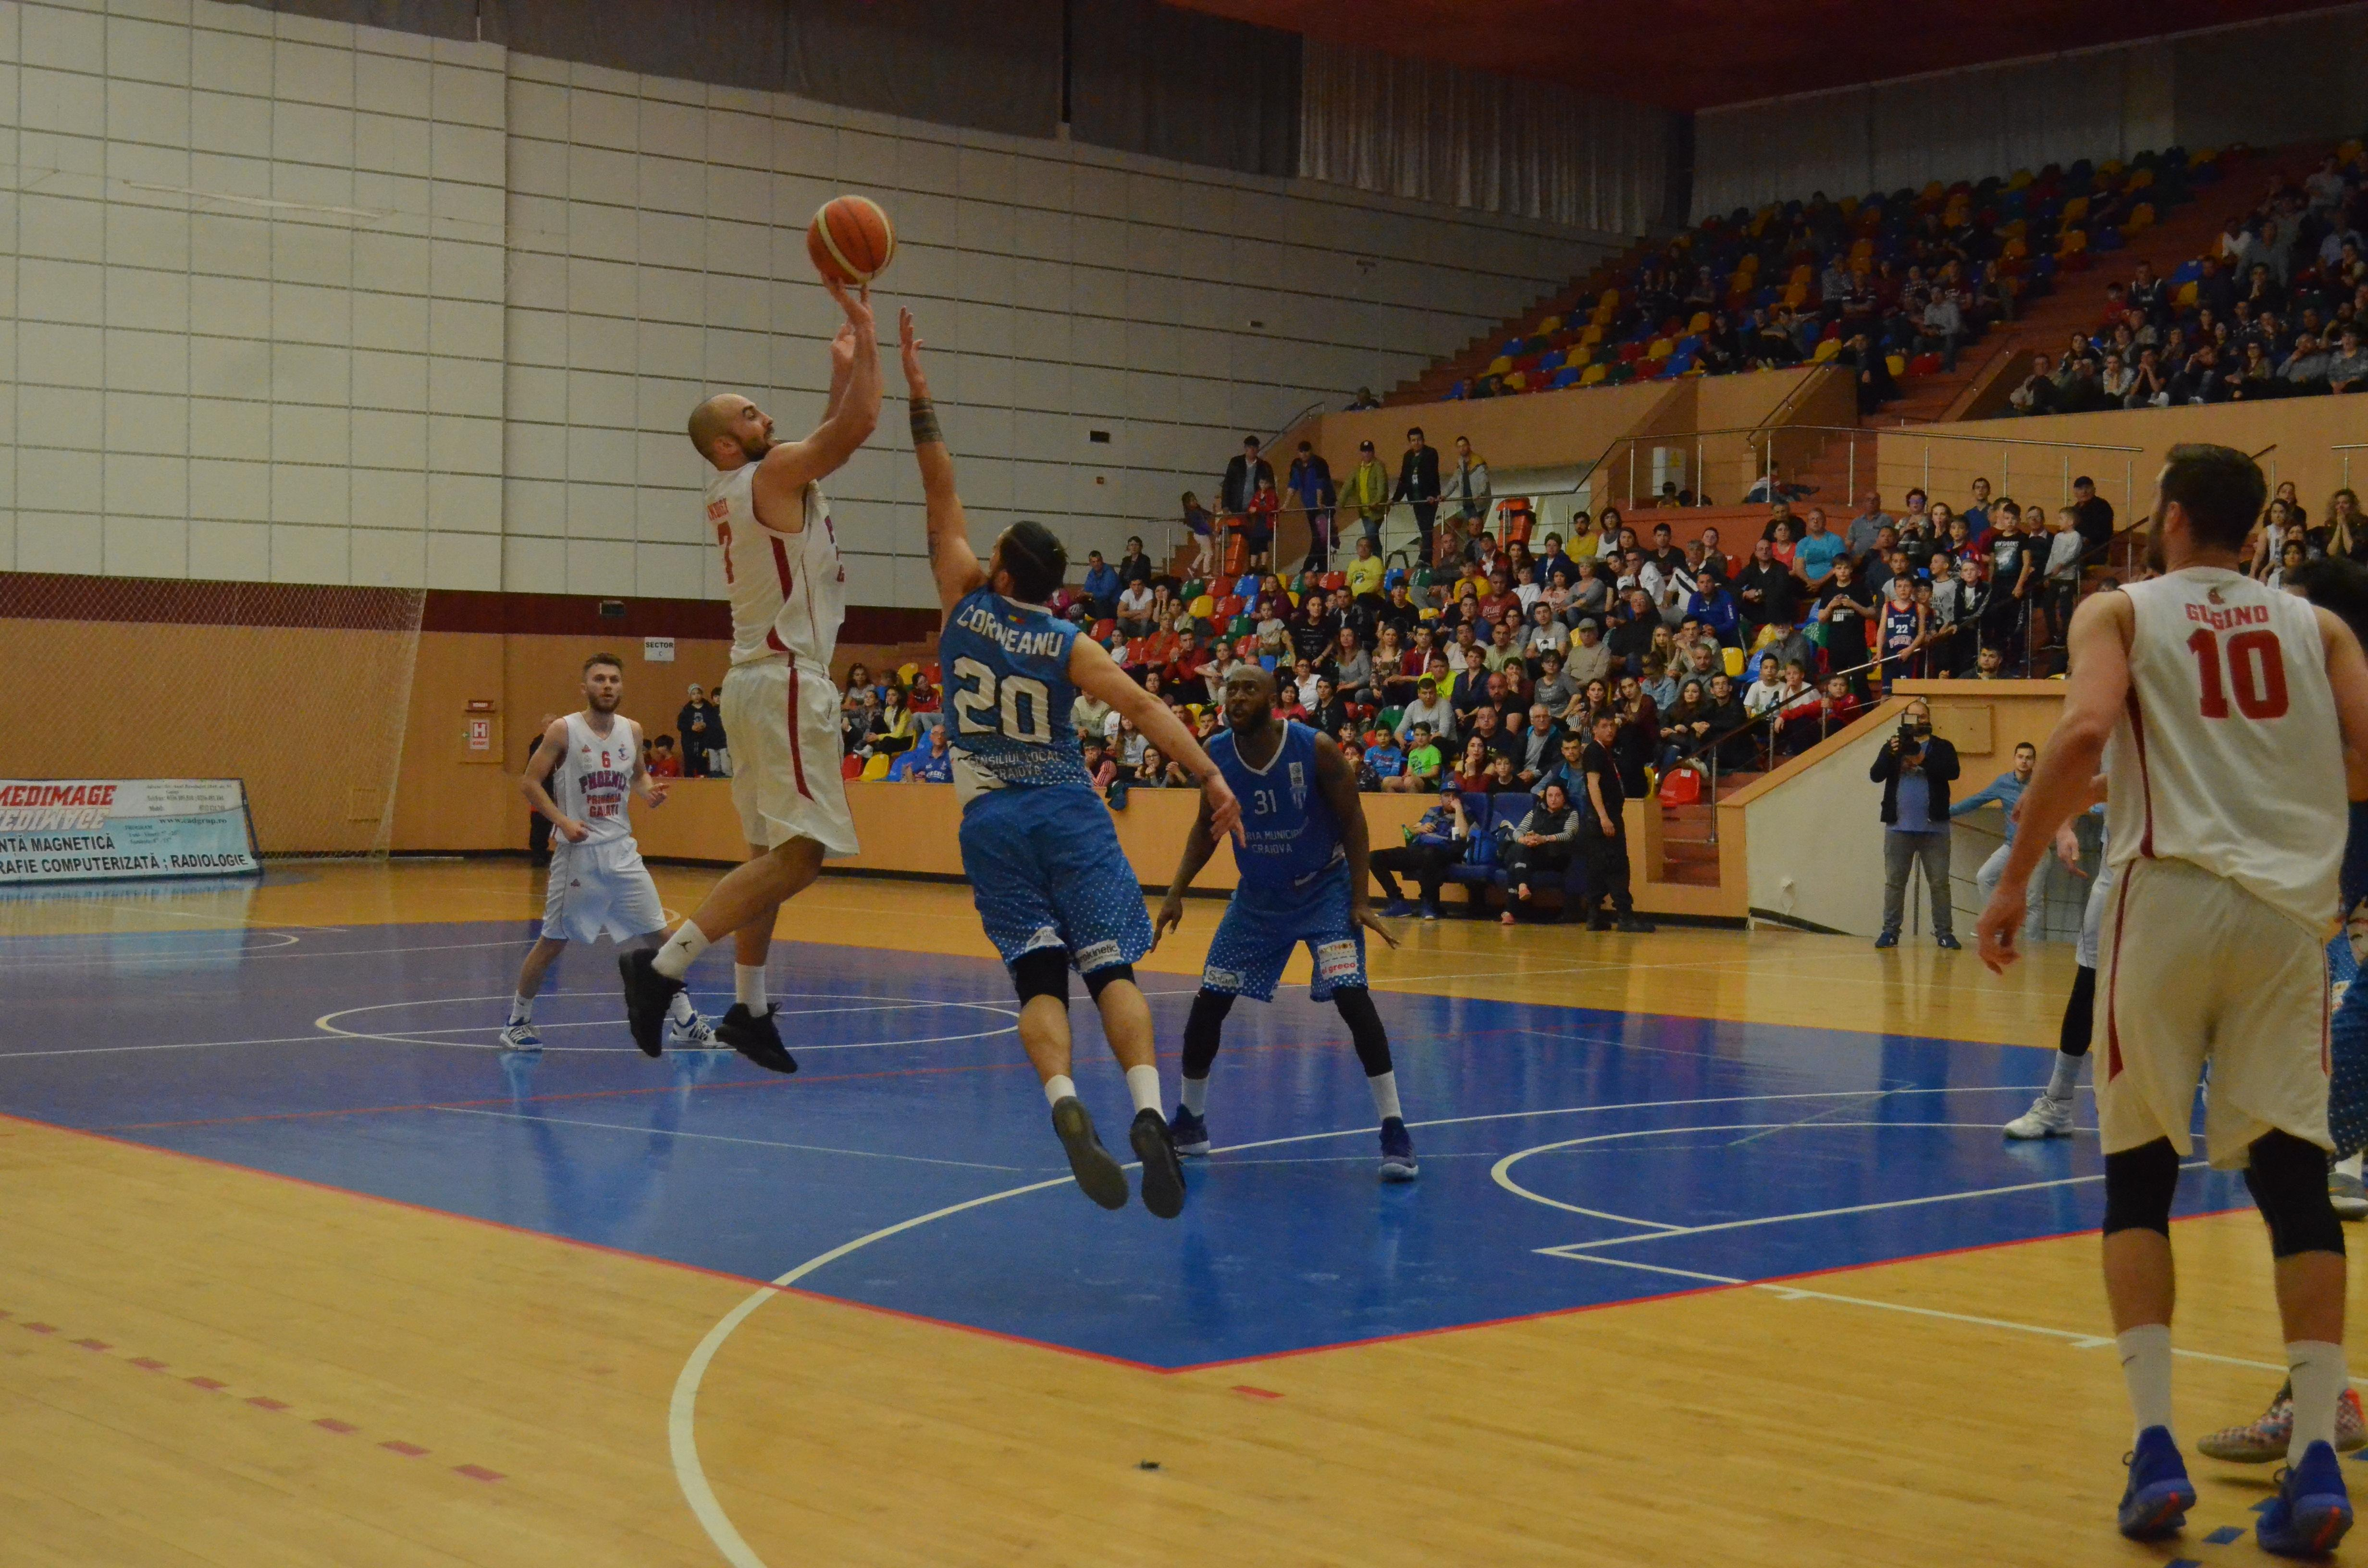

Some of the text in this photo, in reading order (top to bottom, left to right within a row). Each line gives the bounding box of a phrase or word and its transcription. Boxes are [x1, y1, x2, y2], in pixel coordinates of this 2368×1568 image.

[957, 604, 1063, 657] CORNEANU
[1896, 625, 1908, 634] 22
[2186, 628, 2289, 720] 10
[954, 656, 1052, 743] 20
[602, 751, 611, 768] 6
[1025, 750, 1061, 763] LOCAL
[1254, 789, 1276, 815] 31
[31, 833, 115, 852] MAGNETICĂ
[1252, 843, 1293, 854] CRAIOVA
[41, 852, 160, 872] COMPUTERIZATĂ
[170, 854, 249, 868] RADIOLOGIE
[1328, 963, 1356, 974] greco
